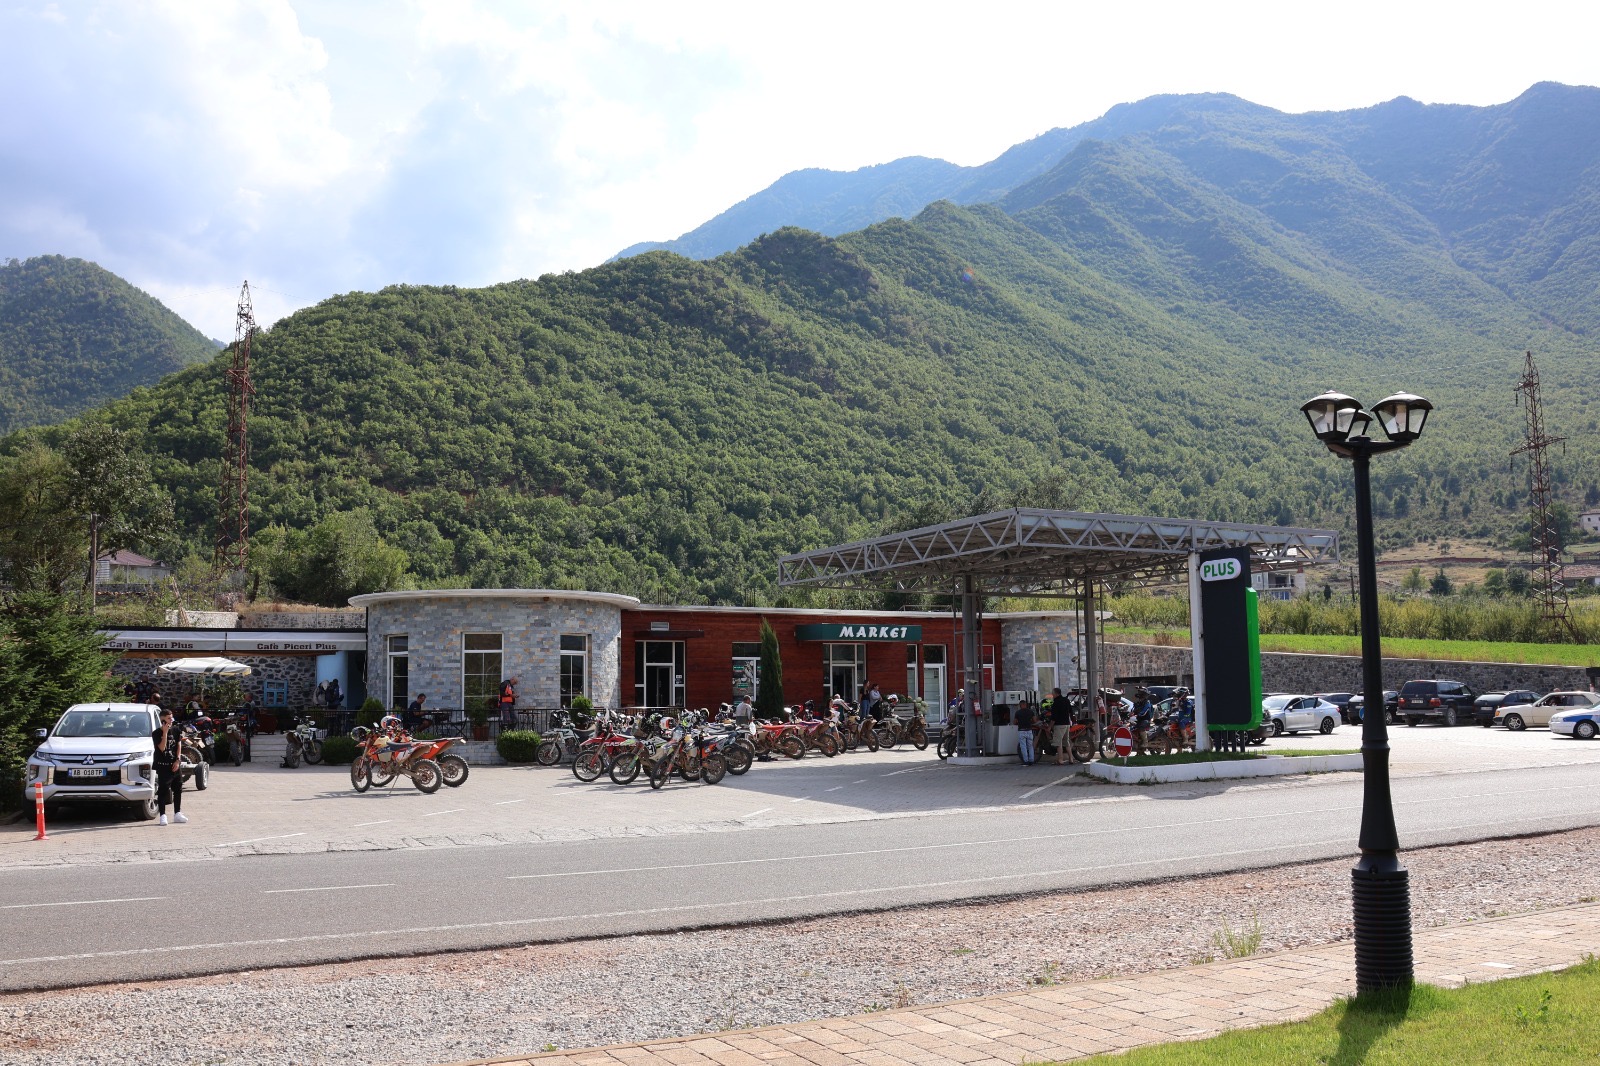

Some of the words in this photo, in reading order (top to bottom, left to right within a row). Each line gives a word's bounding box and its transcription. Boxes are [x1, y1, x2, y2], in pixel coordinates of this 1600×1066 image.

[1203, 561, 1235, 578] PLUS
[839, 626, 907, 638] MARKET
[137, 641, 167, 649] Piceri
[284, 642, 312, 650] Piceri
